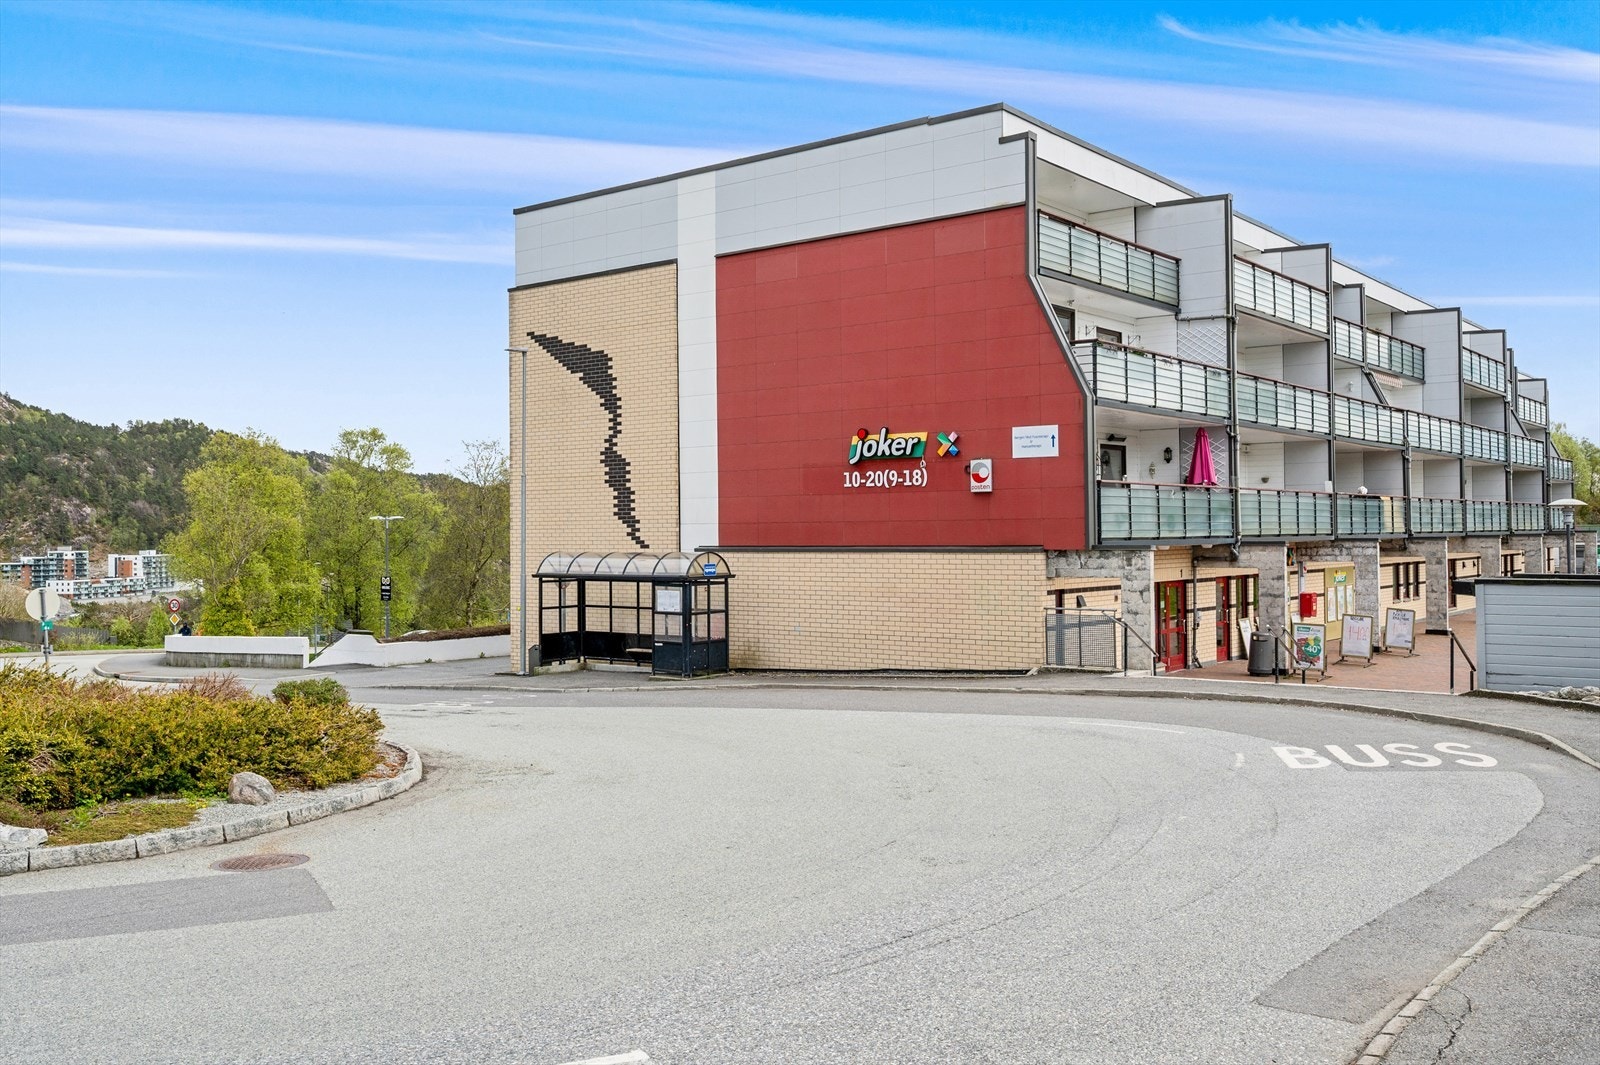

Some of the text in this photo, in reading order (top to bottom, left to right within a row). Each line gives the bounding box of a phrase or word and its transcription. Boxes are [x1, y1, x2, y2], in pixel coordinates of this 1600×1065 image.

[849, 427, 919, 465] joker
[843, 467, 928, 488] 10-20(9-18)
[1271, 742, 1498, 769] BUSS
